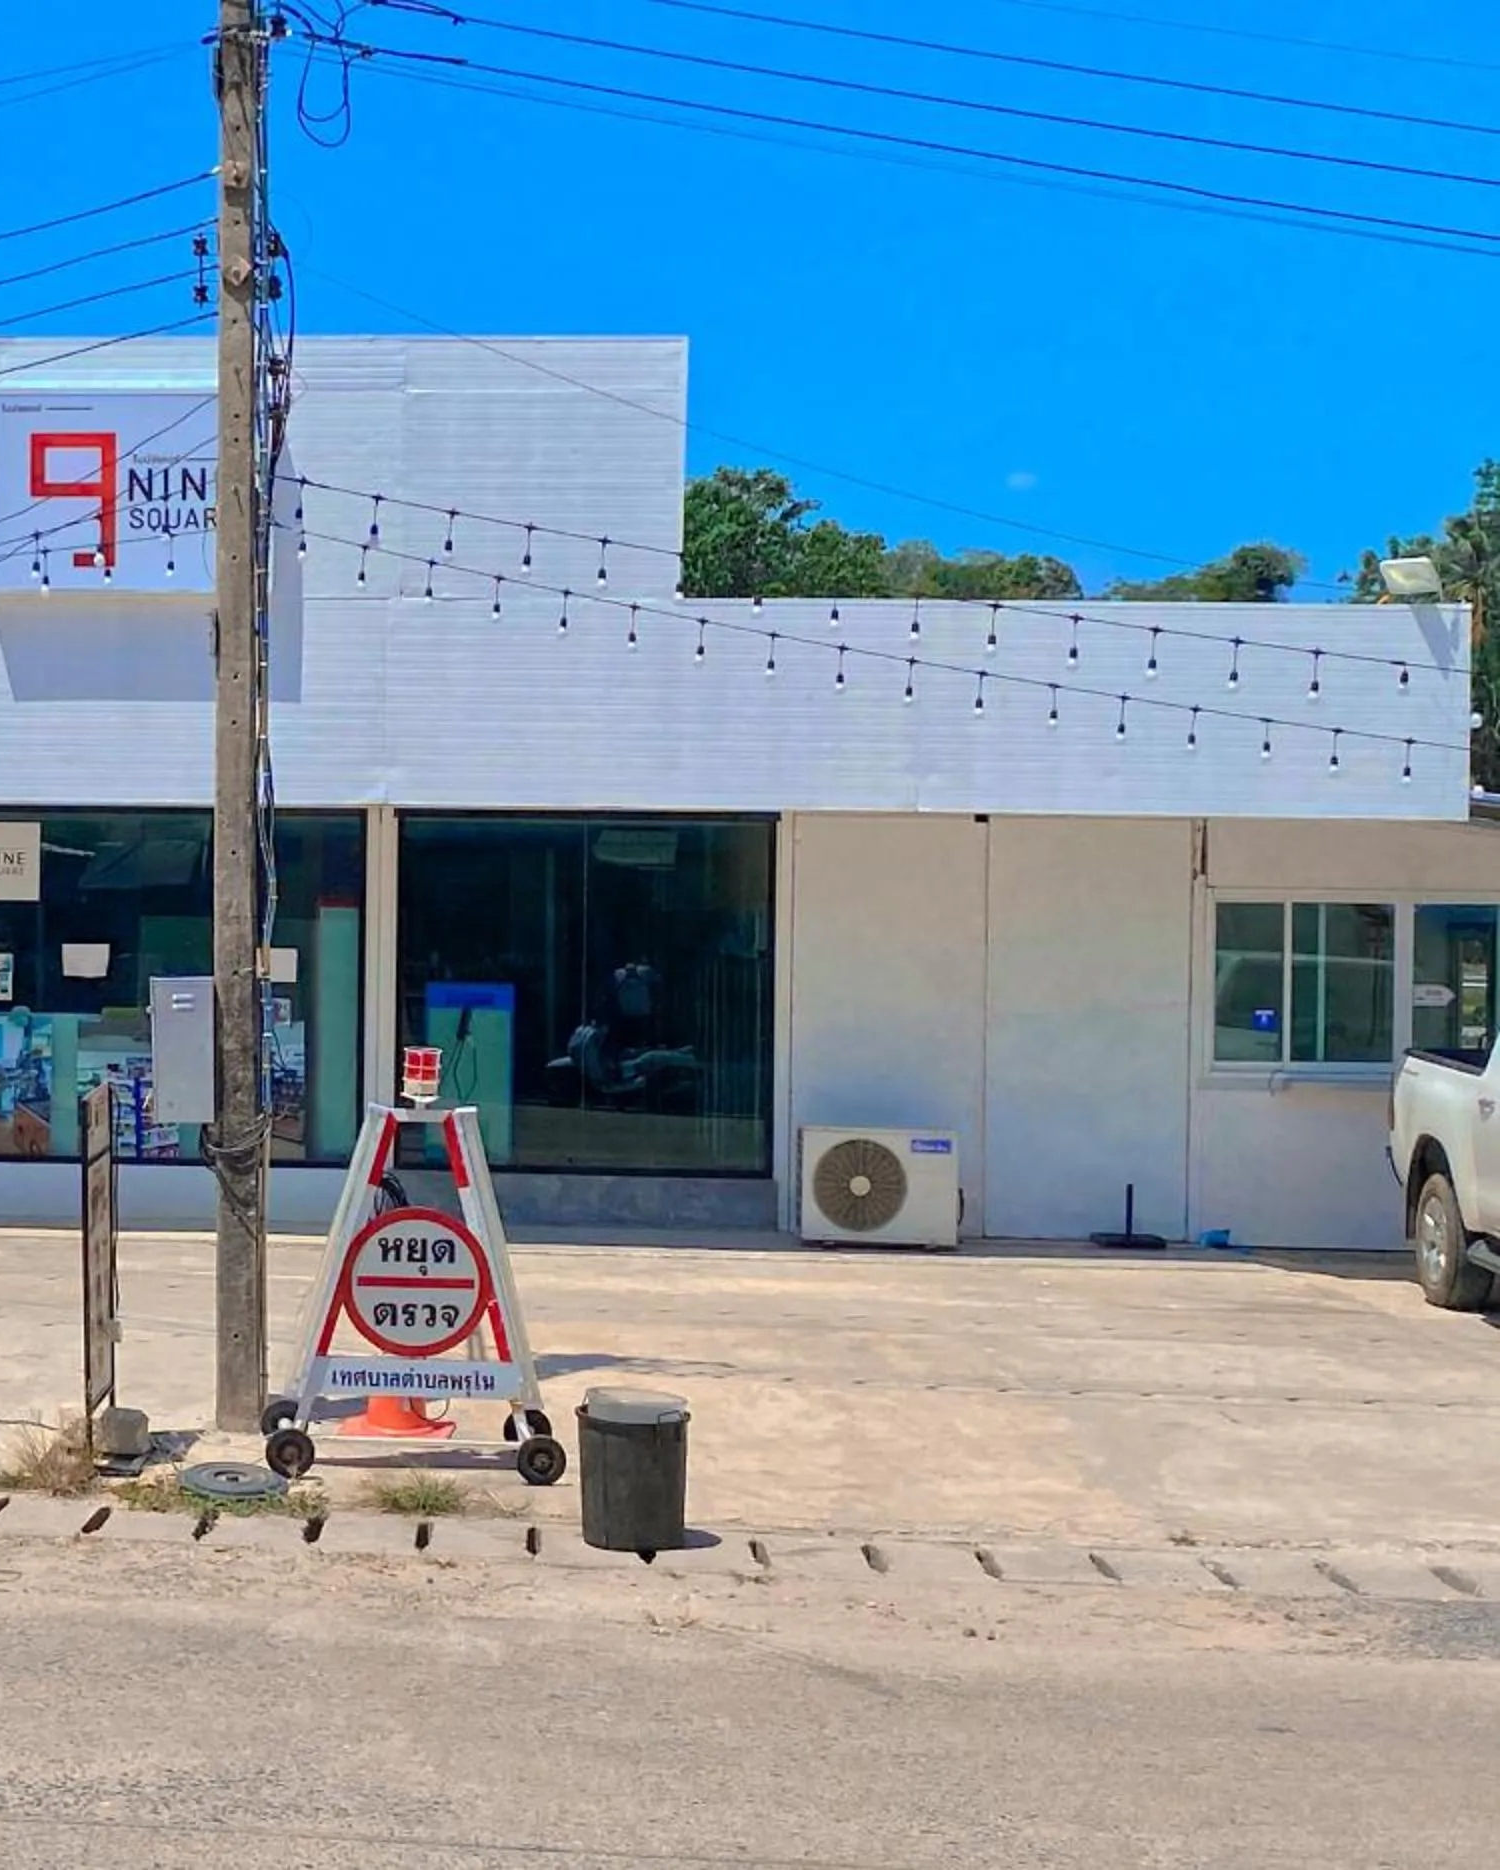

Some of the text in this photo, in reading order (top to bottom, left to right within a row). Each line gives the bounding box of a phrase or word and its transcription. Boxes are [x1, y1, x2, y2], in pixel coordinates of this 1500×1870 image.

[30, 433, 116, 567] 9
[128, 467, 207, 502] NIN
[129, 507, 217, 532] SQUAR
[377, 1236, 455, 1277] หยุด
[373, 1302, 460, 1329] ตรวจ
